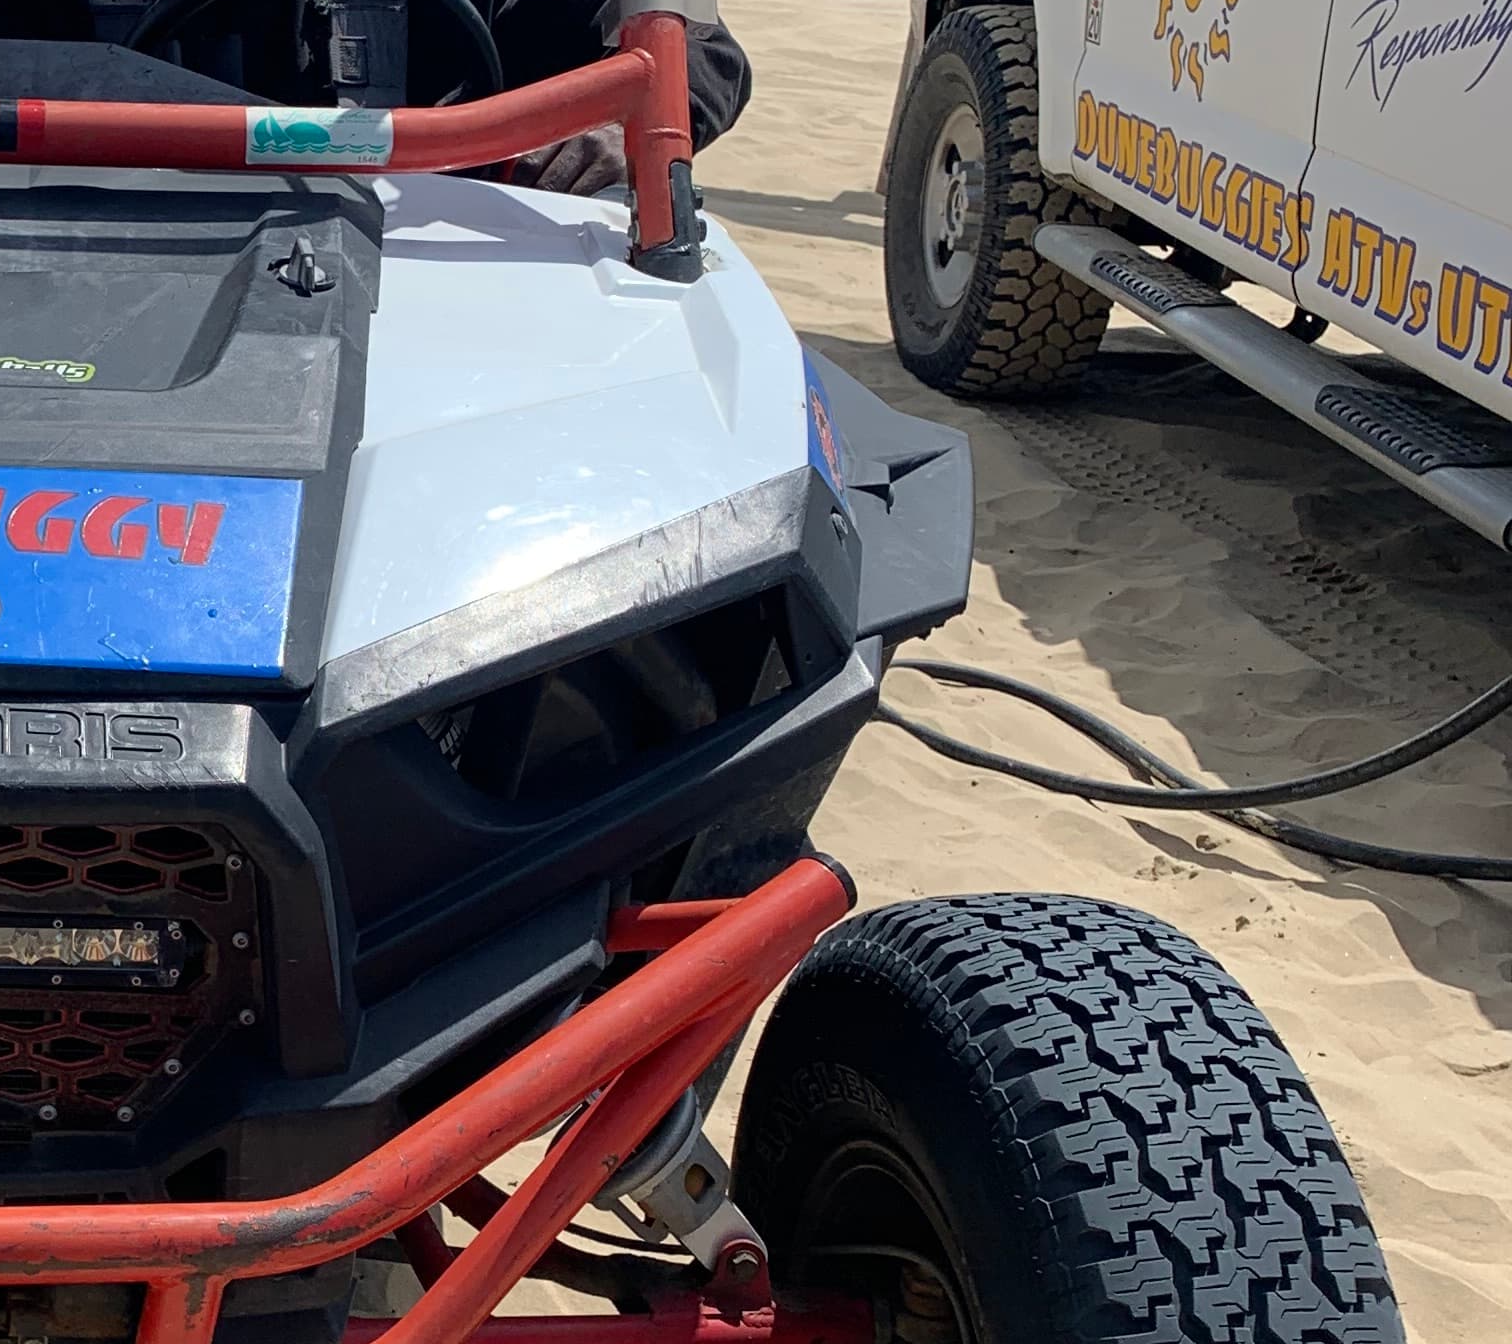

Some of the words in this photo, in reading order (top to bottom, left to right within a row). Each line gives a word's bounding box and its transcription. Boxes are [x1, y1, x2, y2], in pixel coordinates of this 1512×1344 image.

[1074, 90, 1315, 272] DUNEBUGGIES
[1317, 207, 1432, 336] ATVs
[1437, 262, 1512, 388] UT
